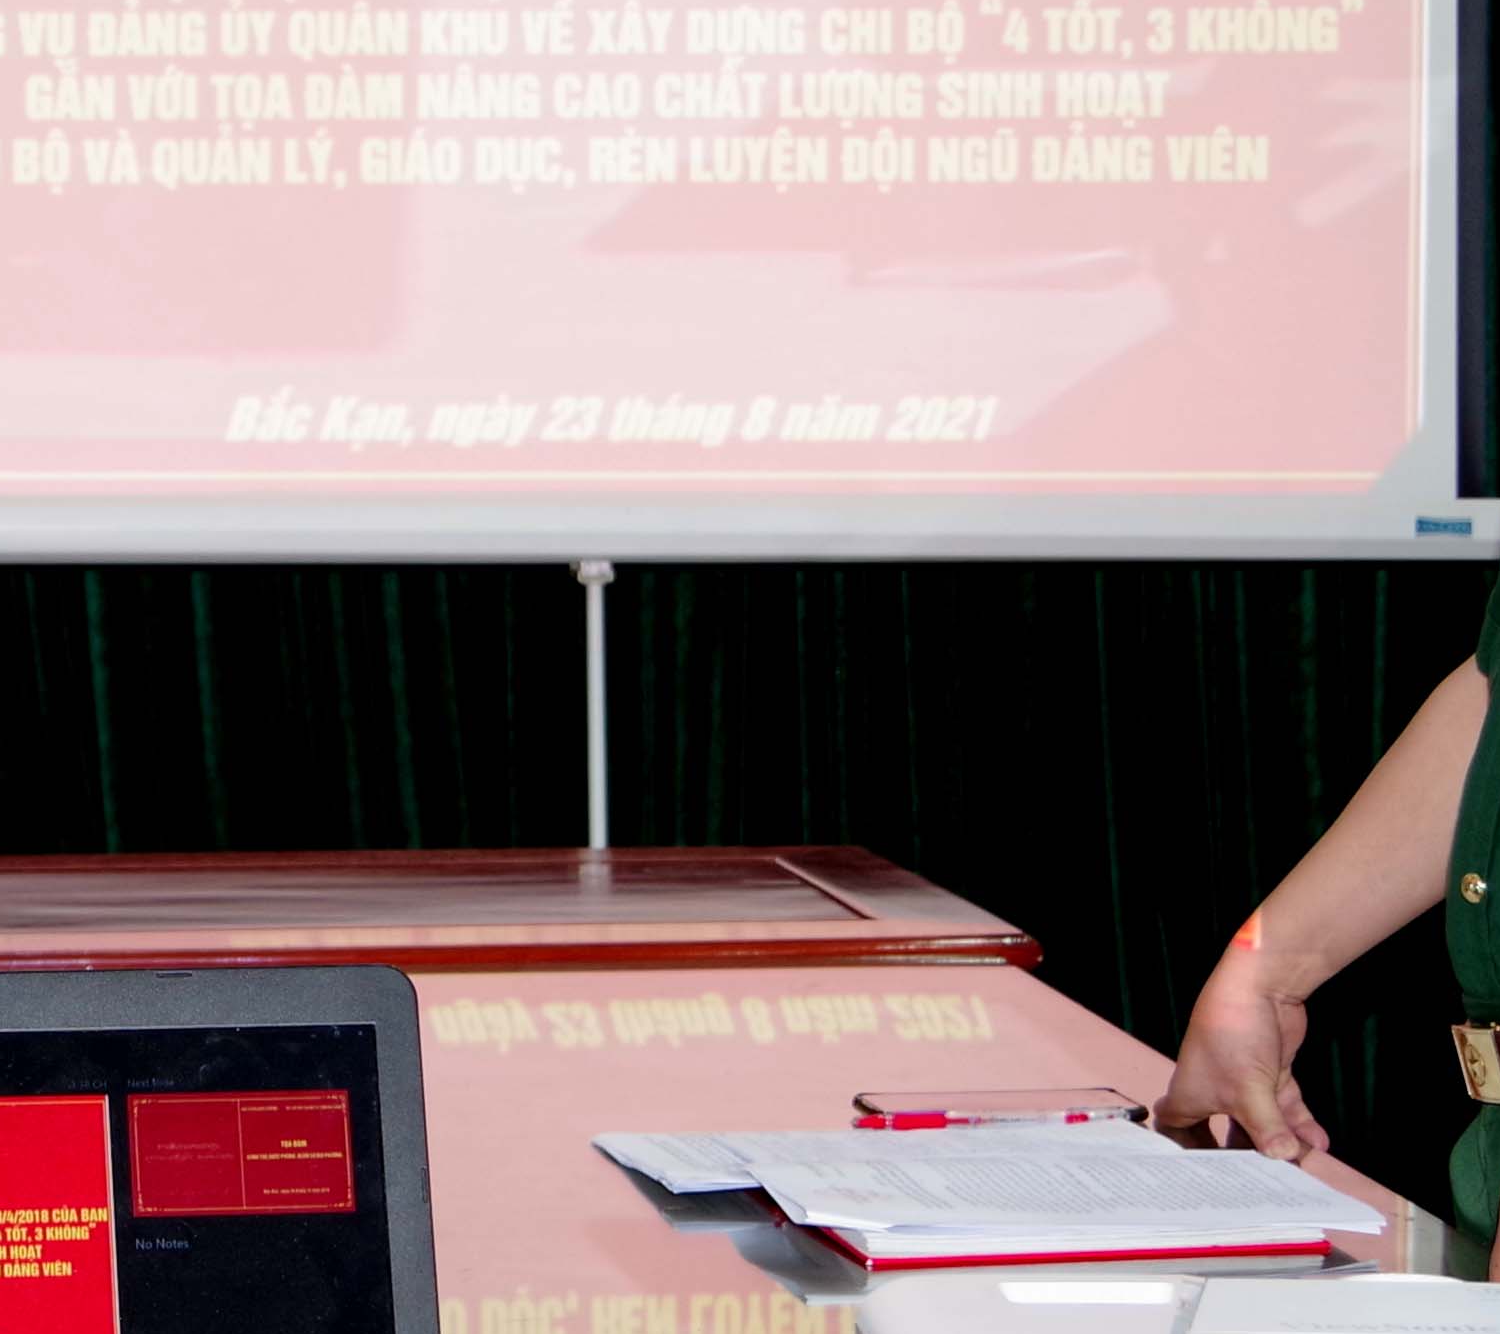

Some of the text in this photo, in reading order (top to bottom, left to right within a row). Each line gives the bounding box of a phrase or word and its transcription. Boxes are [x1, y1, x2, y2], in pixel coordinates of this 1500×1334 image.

[18, 11, 75, 67] VỤ
[87, 0, 206, 57] ĐẢNG
[288, 3, 408, 60] QUÂN
[420, 11, 509, 56] KHU
[586, 2, 673, 54] XÂY
[686, 5, 805, 63] DỰNG
[819, 8, 893, 54] CHI
[907, 0, 965, 63] BỘ
[1146, 8, 1173, 52] 3
[24, 57, 1169, 130] GẮN VỚI TỌA ĐÀM NÂNG CAO CHẤT LƯỢNG SINH HOẠT
[13, 128, 71, 195] BỘ
[83, 128, 140, 185] VÀ
[152, 123, 272, 188] QUẢN
[284, 128, 347, 189] LÝ,
[359, 126, 463, 185] GIÁO
[475, 139, 576, 195] DỤC,
[590, 126, 678, 183] RÈN
[690, 127, 829, 193] LUYỆN
[842, 127, 915, 193] ĐỘI
[928, 126, 1018, 183] NGŨ
[1032, 122, 1153, 183] ĐẢNG
[1167, 127, 1269, 182] VIÊN
[226, 385, 997, 451] Bắc Kạn, ngày 23 tháng 8 năm 2021
[136, 1238, 189, 1250] No Notes
